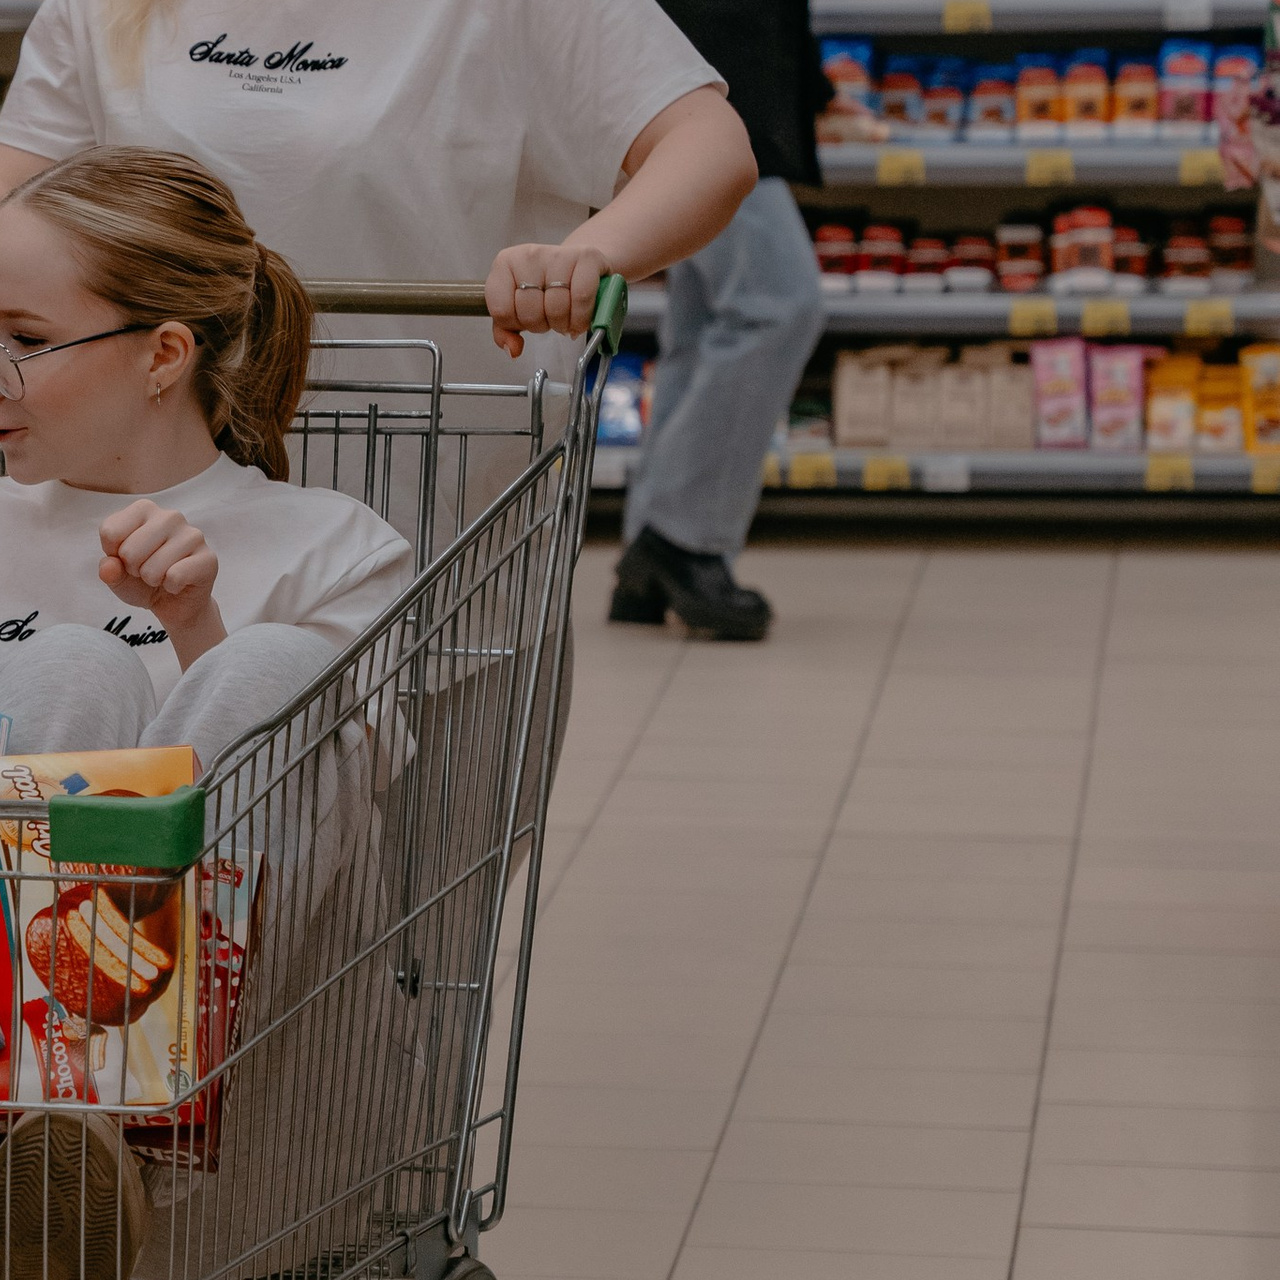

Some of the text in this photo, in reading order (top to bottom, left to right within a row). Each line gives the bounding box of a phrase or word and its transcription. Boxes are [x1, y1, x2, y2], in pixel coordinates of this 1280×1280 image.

[189, 33, 349, 73] Santa Monica
[228, 70, 244, 80] Los
[245, 73, 278, 84] Angeles
[241, 82, 283, 94] California
[167, 1043, 188, 1064] 12
